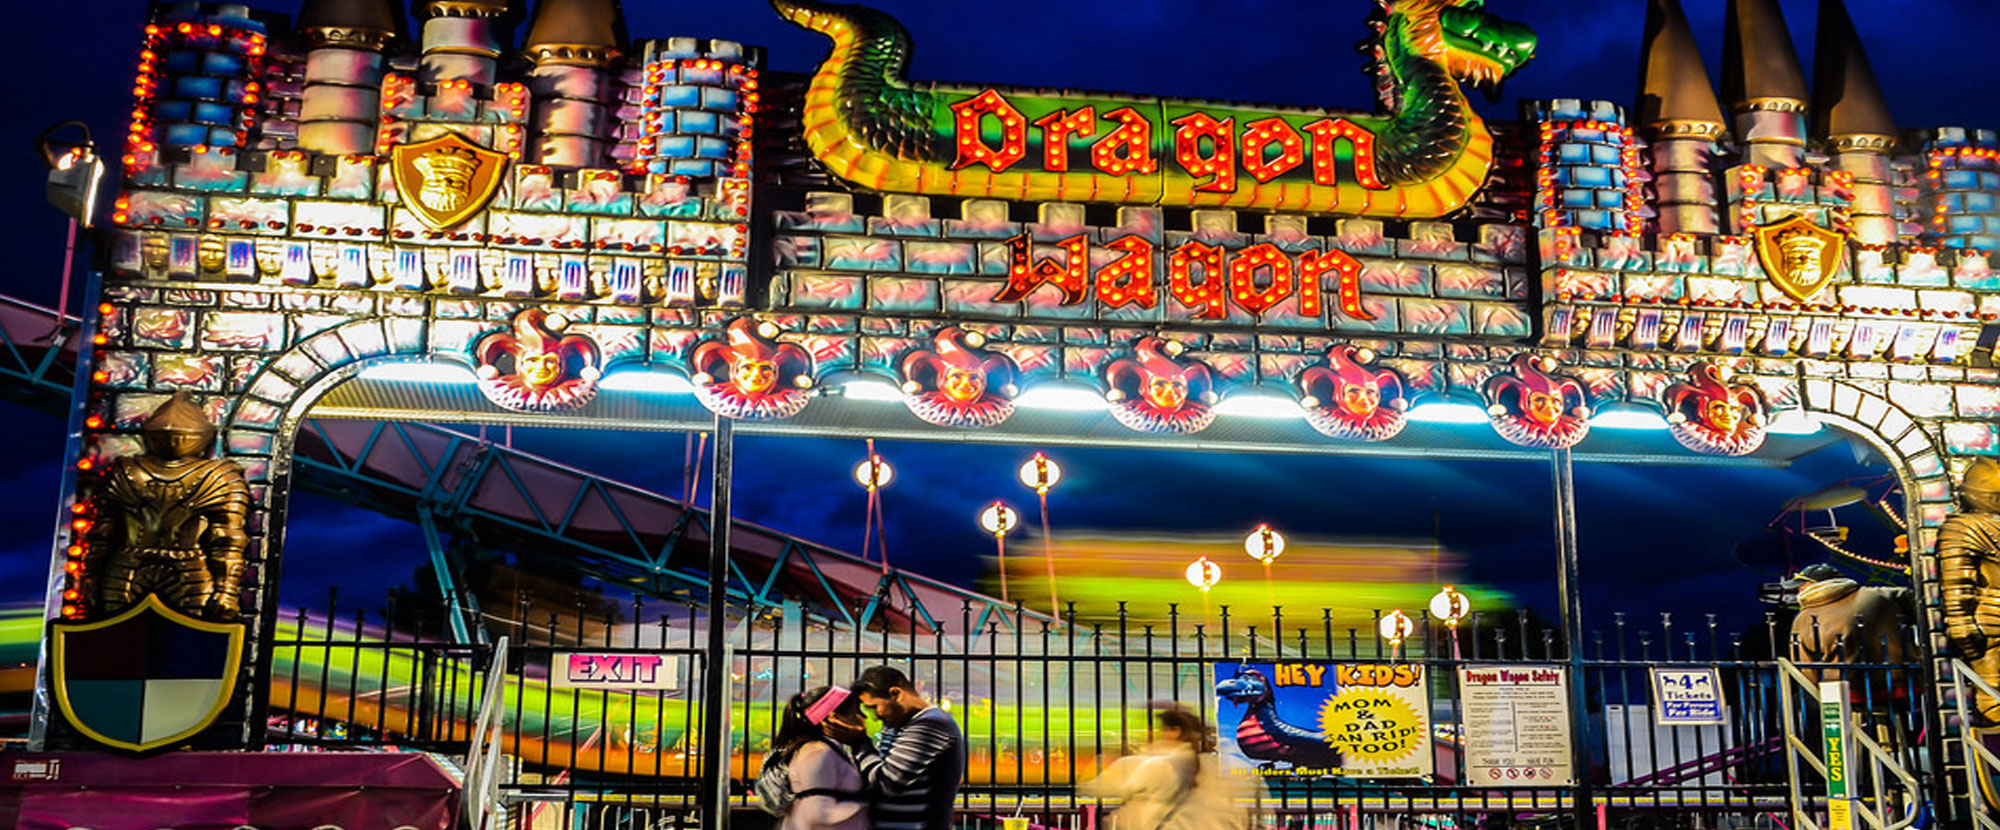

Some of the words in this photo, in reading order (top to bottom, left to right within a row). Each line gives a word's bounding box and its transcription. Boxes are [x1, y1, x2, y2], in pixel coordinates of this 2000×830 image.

[947, 88, 1391, 193] Dragon
[994, 230, 1377, 320] Wagon
[568, 654, 662, 683] EXIT
[1274, 663, 1327, 688] HEY
[1336, 663, 1421, 688] KIDS!
[1466, 669, 1498, 685] Dragon
[1500, 669, 1529, 685] Wagon
[1531, 669, 1560, 685] Safety
[1679, 674, 1692, 689] 4
[1666, 691, 1712, 699] Tickets
[1334, 698, 1392, 712] MOM
[1356, 709, 1375, 719] &
[1344, 719, 1396, 732] DAD
[1348, 739, 1405, 753] TOO!
[1827, 737, 1843, 782] YES
[1251, 767, 1292, 776] Riders
[1295, 767, 1328, 776] Must
